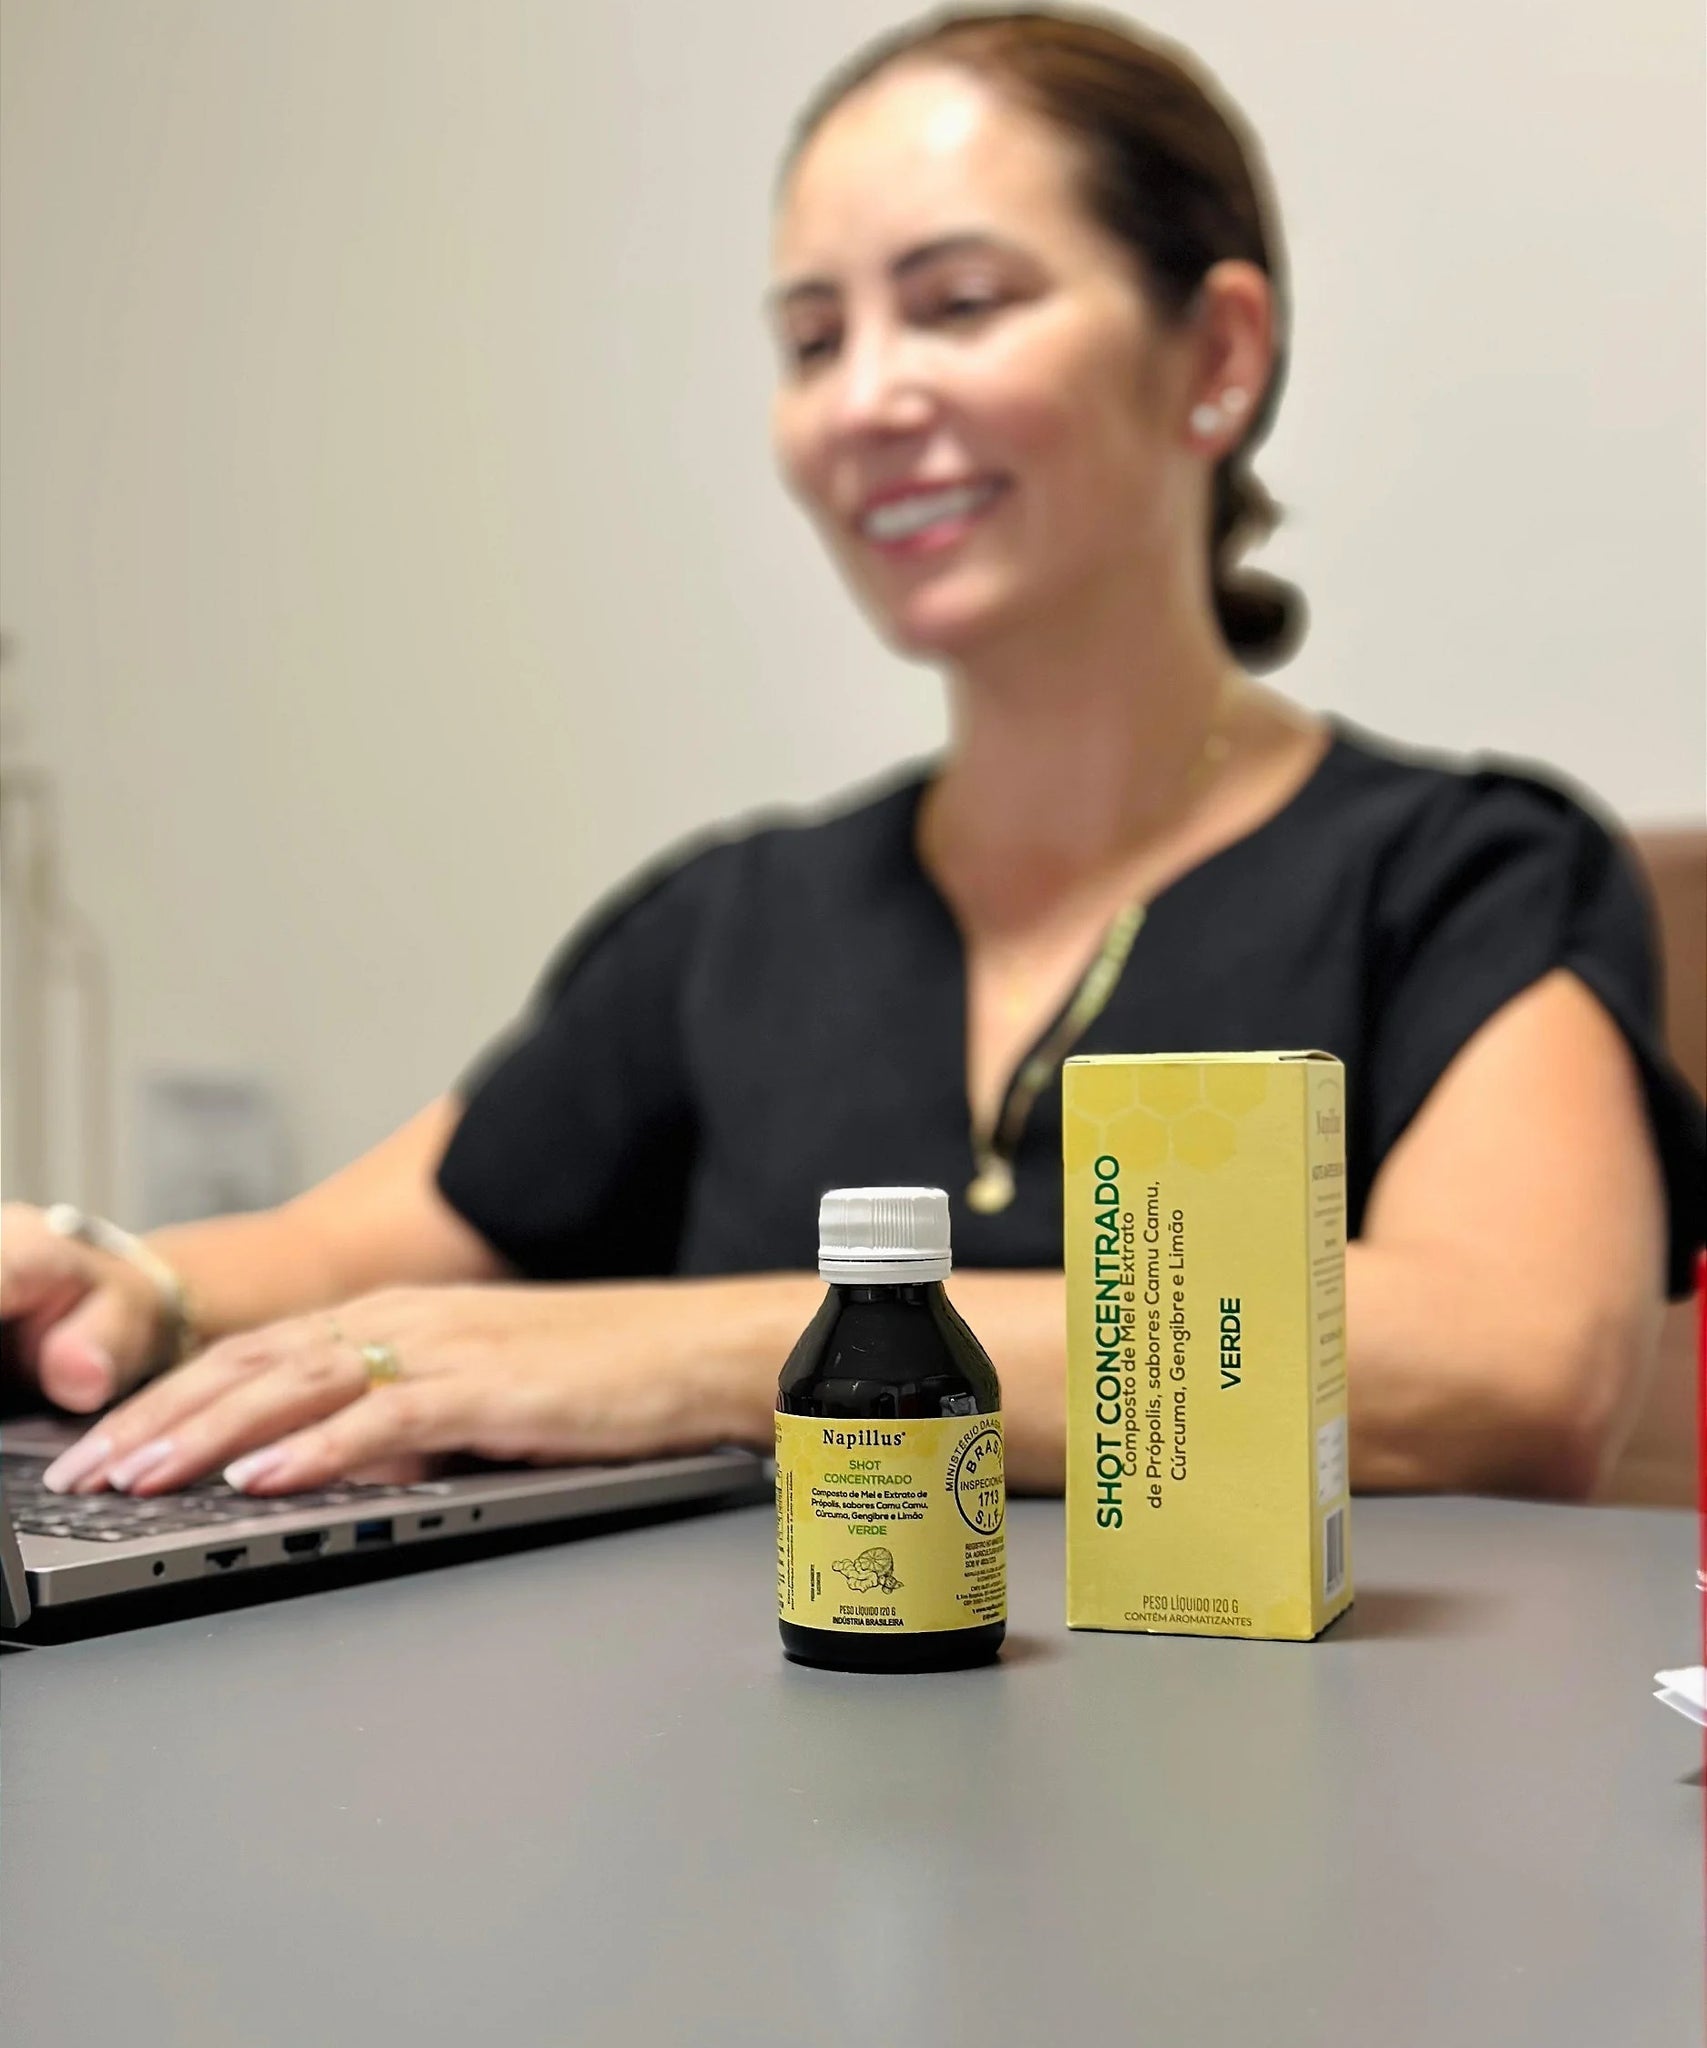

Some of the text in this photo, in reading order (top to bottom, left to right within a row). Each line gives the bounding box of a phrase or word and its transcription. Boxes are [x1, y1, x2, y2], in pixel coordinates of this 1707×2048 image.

[1094, 1155, 1123, 1529] SHOT CONCENTRADO
[1120, 1211, 1141, 1477] Composto de Mel e Extrato
[1143, 1181, 1165, 1509] de Própolis, sabores Camu Camu,
[1168, 1208, 1191, 1481] Cúrcuma, Gengibre e Limão
[1219, 1297, 1242, 1390] VERDE
[823, 1429, 902, 1449] Napillus
[849, 1460, 881, 1471] SHOT
[824, 1473, 913, 1485] CONCENTRADO
[811, 1488, 848, 1498] Composto
[861, 1491, 876, 1499] Mel
[884, 1491, 916, 1499] Extrato
[917, 1490, 928, 1498] de
[978, 1489, 999, 1507] 1713
[842, 1501, 875, 1509] sabores
[876, 1501, 901, 1509] Camu
[851, 1511, 889, 1522] Gengibre
[848, 1525, 887, 1535] VERDE
[839, 1605, 854, 1615] PESO
[855, 1604, 879, 1617] LÍQUIDO
[1142, 1595, 1240, 1614] PESO LÍQUIDO 120 G
[832, 1616, 905, 1627] INDÚSTRIA BRASILEIRA
[1123, 1611, 1253, 1627] CONTÉM AROMATIZANTES
